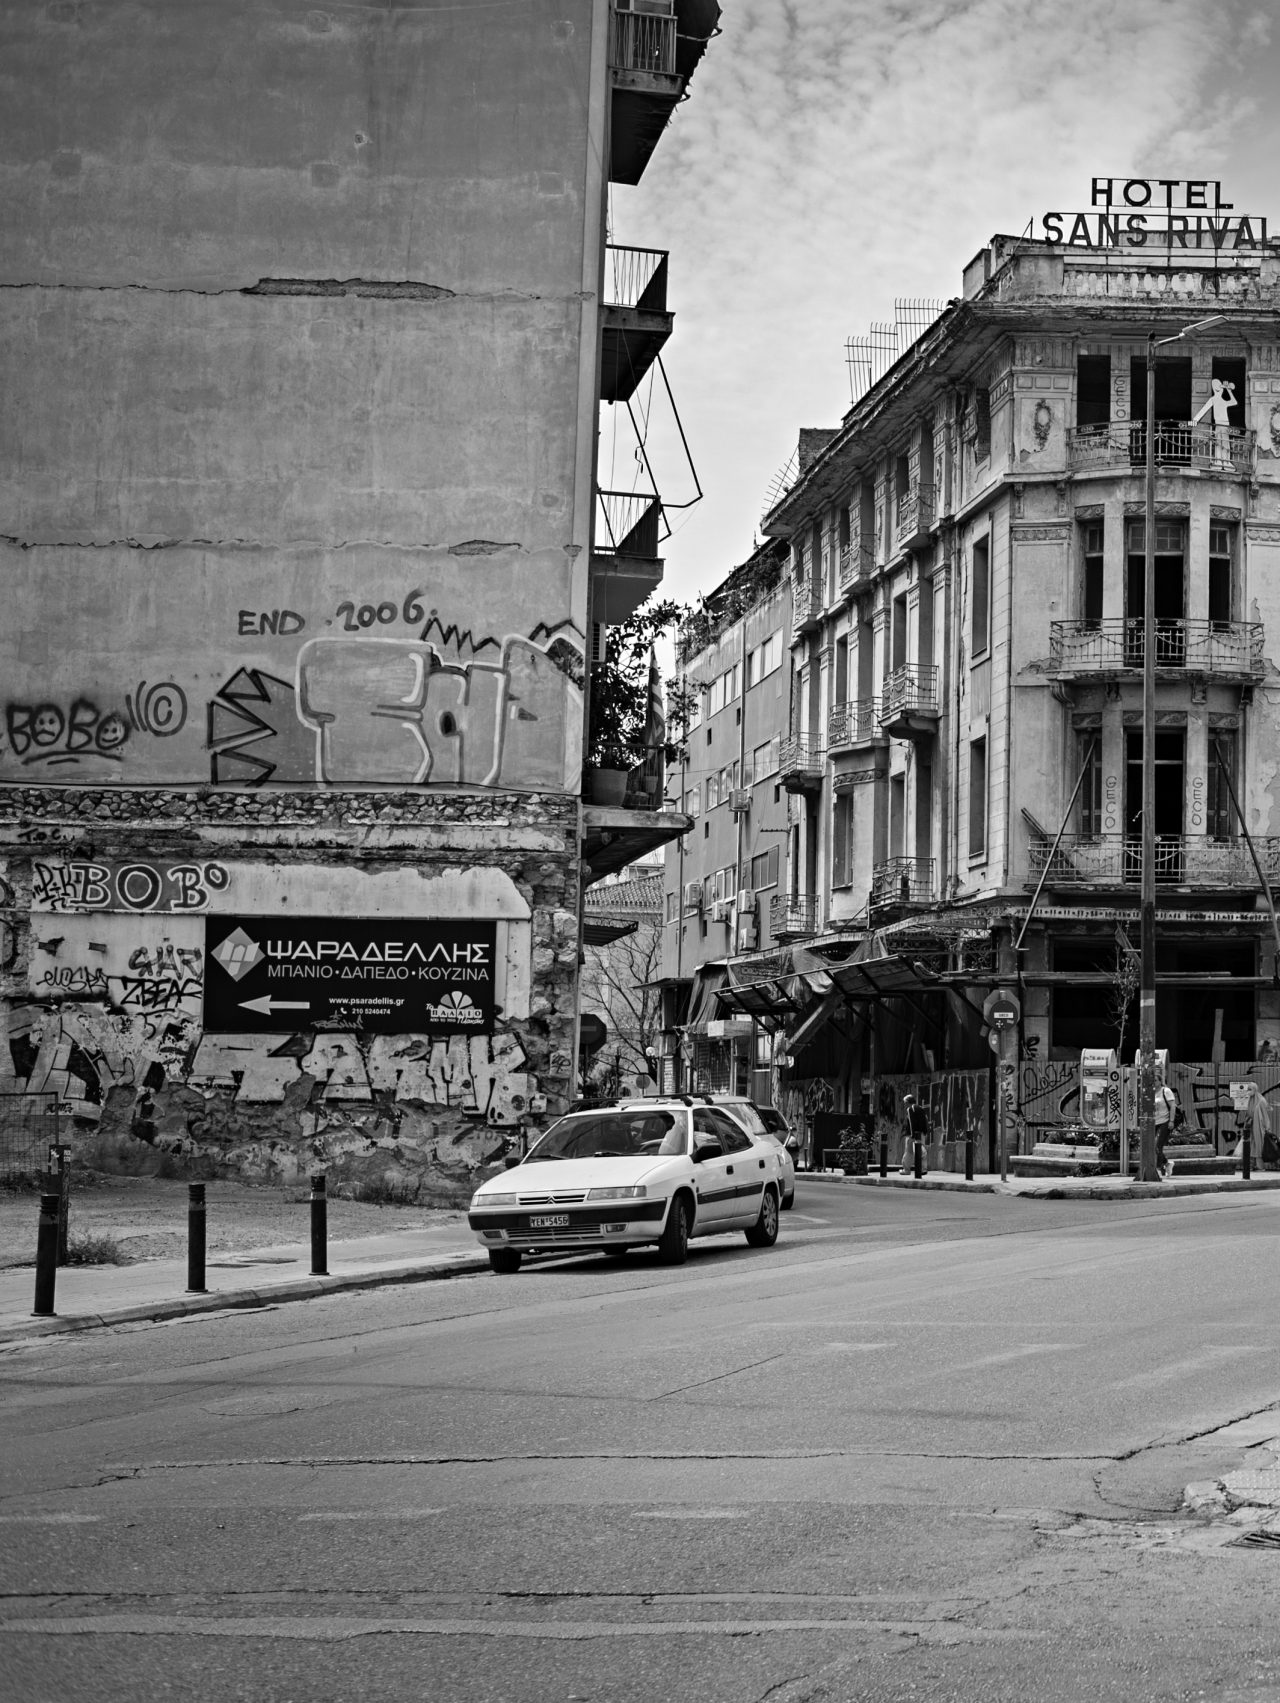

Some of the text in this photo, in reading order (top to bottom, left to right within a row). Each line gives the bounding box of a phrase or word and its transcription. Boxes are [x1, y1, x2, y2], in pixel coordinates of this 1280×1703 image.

[1092, 178, 1233, 209] HOTEL
[1043, 213, 1280, 250] SANS RIVAL
[238, 609, 304, 635] END
[6, 698, 132, 756] BOBO
[1105, 776, 1117, 829] GECO
[1192, 777, 1203, 826] GECO
[66, 861, 230, 910] BOBO
[267, 940, 490, 963] ΨΑΡΑΔΕΛΛΗΣ
[268, 964, 490, 982] ΜΠΑΝΙΟ ΔΑΠΕΔΟ ΚΟΥΖΙΝΑ
[329, 997, 405, 1006] www.psaradellis.gr
